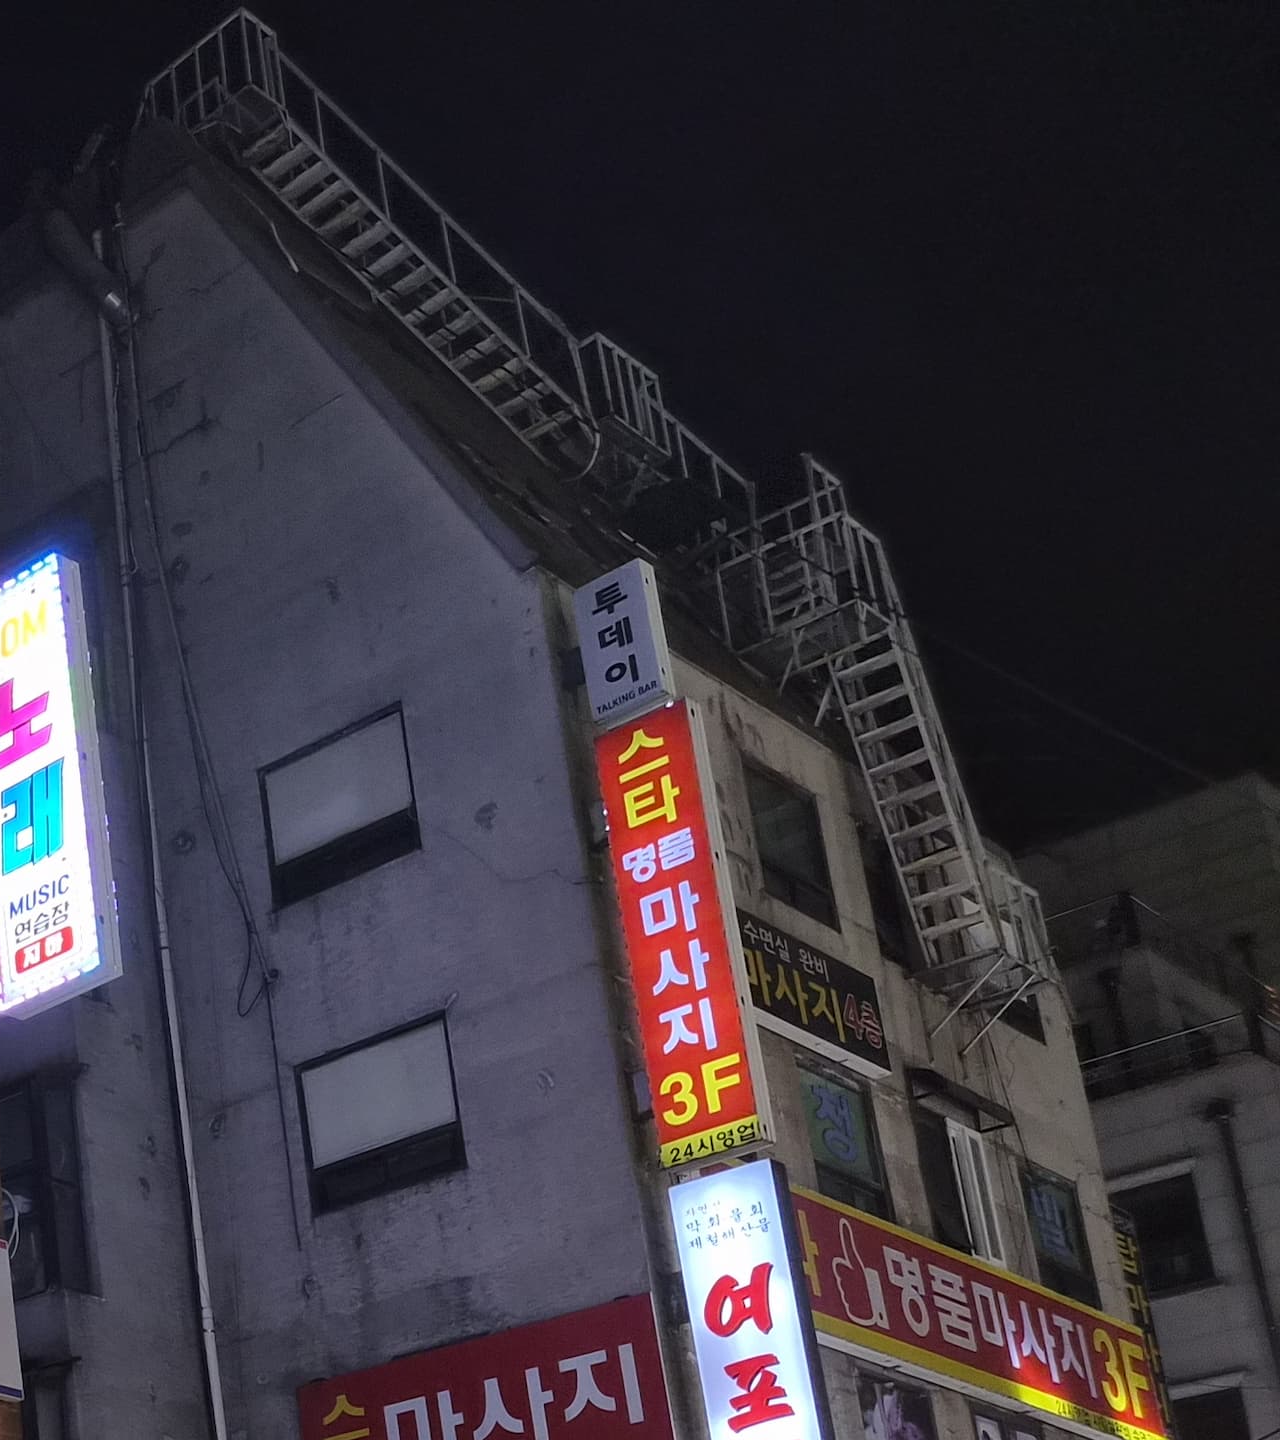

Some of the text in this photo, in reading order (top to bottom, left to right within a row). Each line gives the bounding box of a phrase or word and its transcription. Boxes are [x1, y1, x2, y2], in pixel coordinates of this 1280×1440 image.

[592, 581, 640, 684] 투데이
[596, 680, 658, 715] TALKING BAR
[618, 728, 680, 829] 스타
[623, 829, 695, 884] 명품
[10, 873, 70, 921] MUSIC
[14, 901, 70, 944] 연습장
[22, 934, 67, 969] 지하
[640, 880, 717, 1057] 마사지
[744, 920, 830, 982] 수면실 완비
[843, 993, 882, 1049] 4층
[660, 1053, 743, 1127] 3F
[669, 1122, 757, 1164] 24시영업
[883, 1245, 1098, 1399] 명품마사지
[1093, 1328, 1155, 1418] 3F
